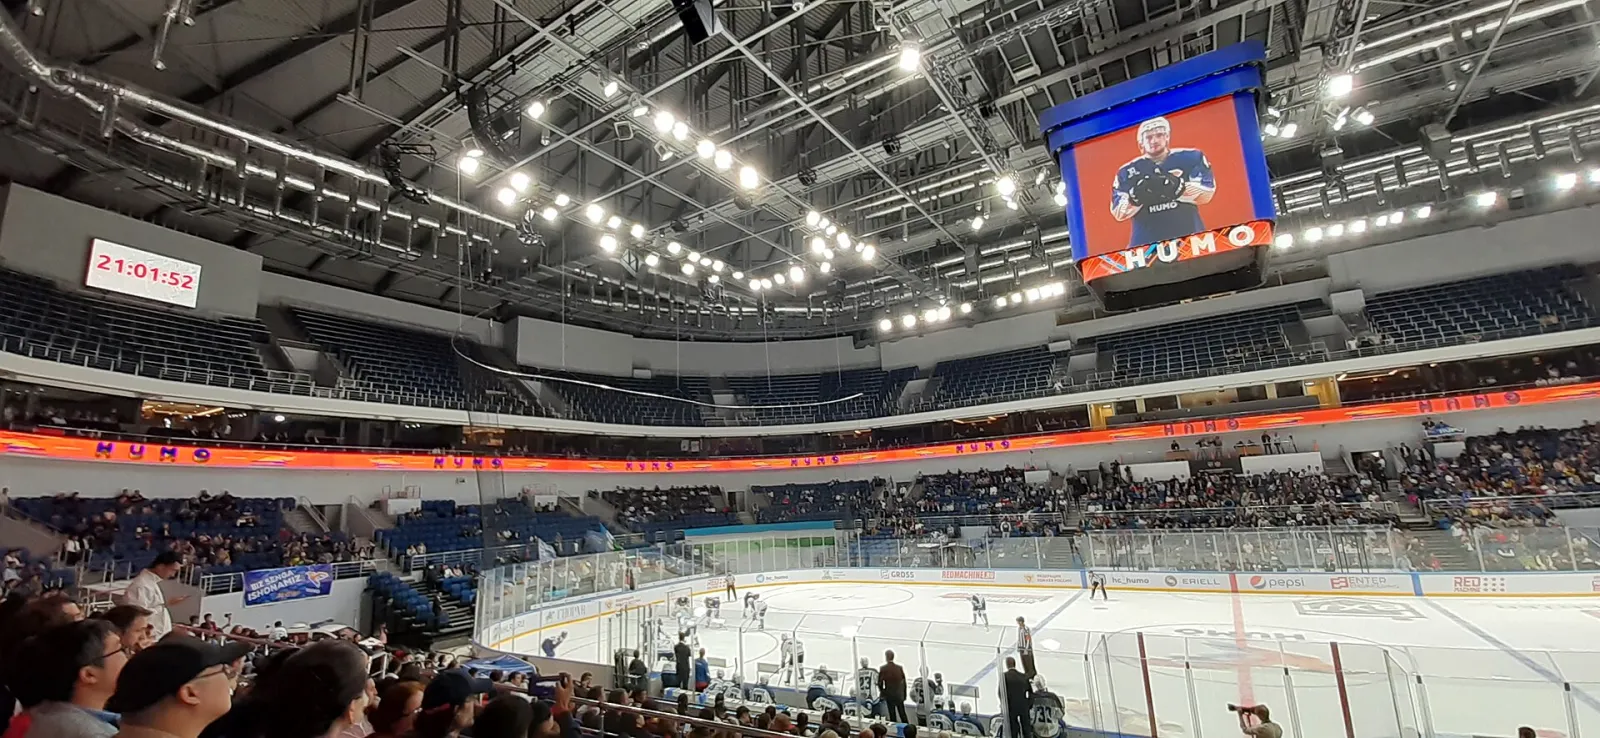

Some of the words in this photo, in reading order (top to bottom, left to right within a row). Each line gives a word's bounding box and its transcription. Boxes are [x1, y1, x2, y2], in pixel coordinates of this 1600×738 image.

[1149, 201, 1178, 213] HUMO
[1125, 224, 1255, 270] HUMO
[97, 254, 193, 290] 21:01:52
[95, 441, 211, 463] HUMO
[247, 574, 301, 601] ISHONAMIZ
[250, 581, 265, 591] BIZ
[264, 570, 295, 586] SENGA
[1112, 576, 1149, 585] hc_humo
[1269, 577, 1305, 588] pepsi
[1348, 577, 1387, 585] ENTER
[1454, 576, 1481, 587] RED
